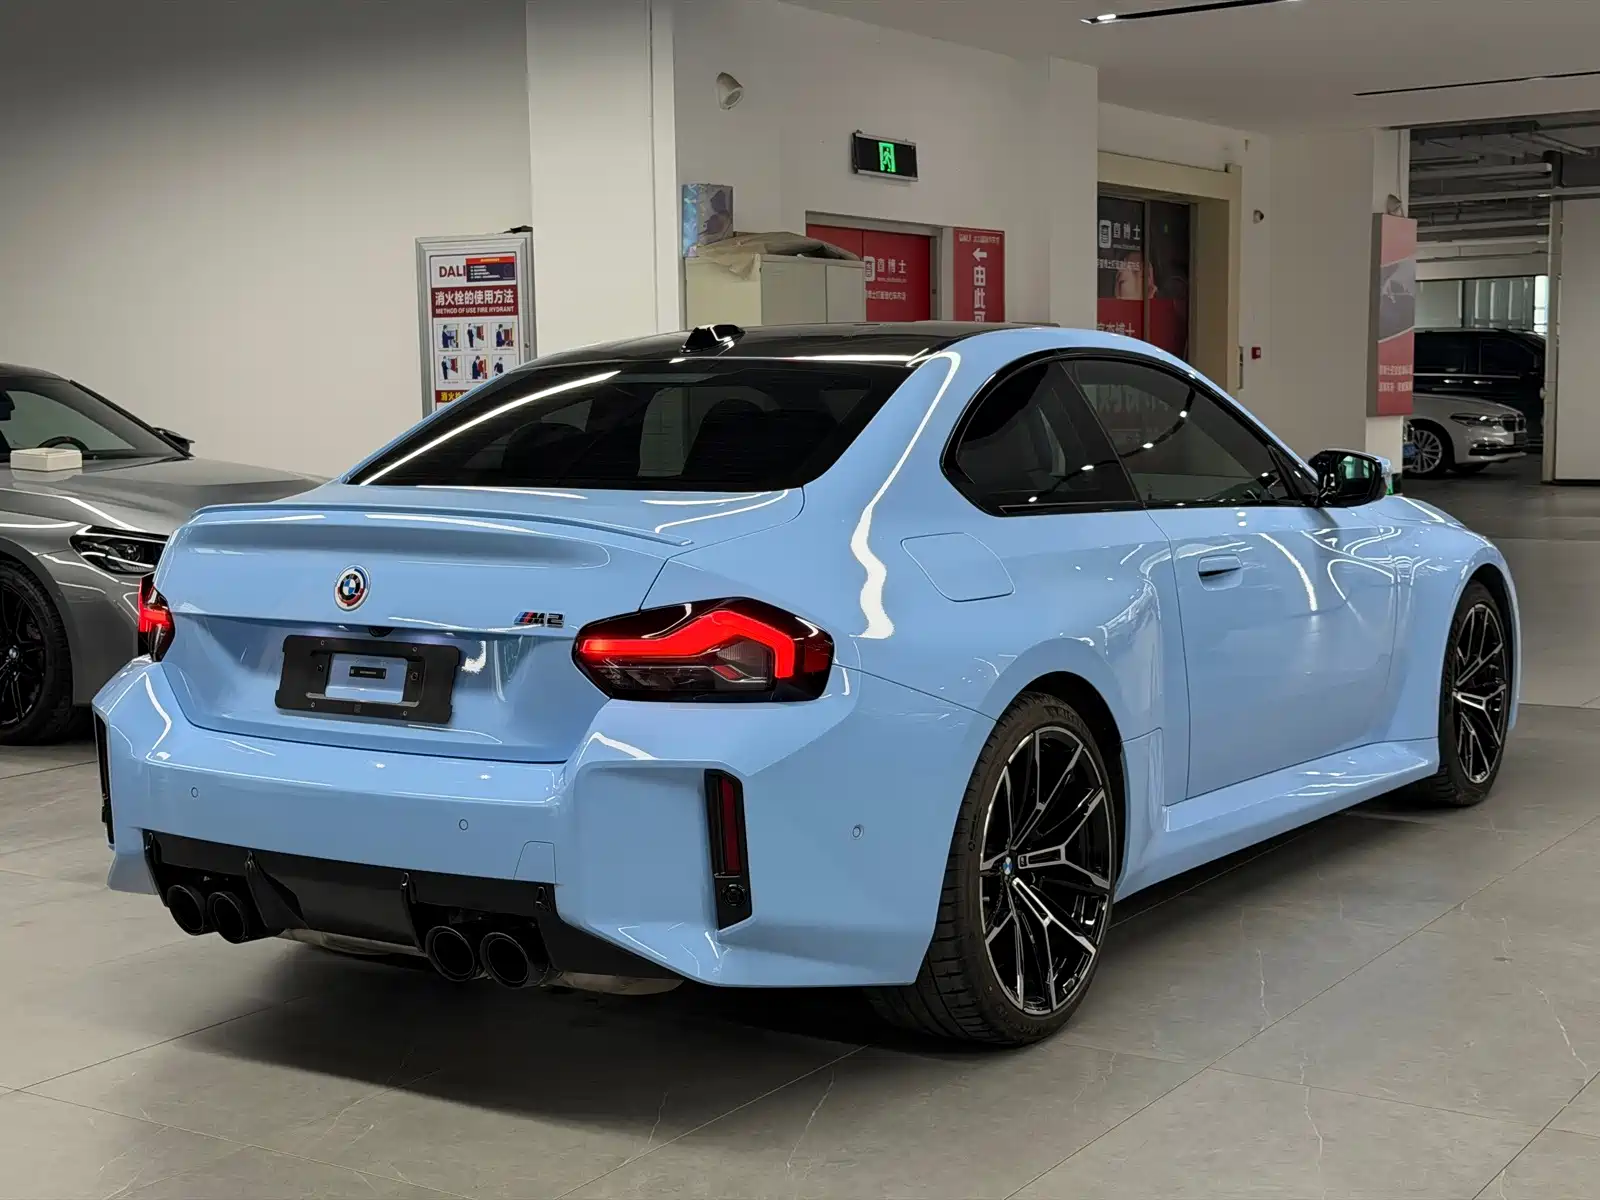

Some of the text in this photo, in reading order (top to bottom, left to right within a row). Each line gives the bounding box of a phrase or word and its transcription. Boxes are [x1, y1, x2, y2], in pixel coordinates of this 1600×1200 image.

[435, 289, 514, 306] 消火栓的使用方法
[436, 307, 458, 315] METHOD
[519, 611, 565, 627] M2
